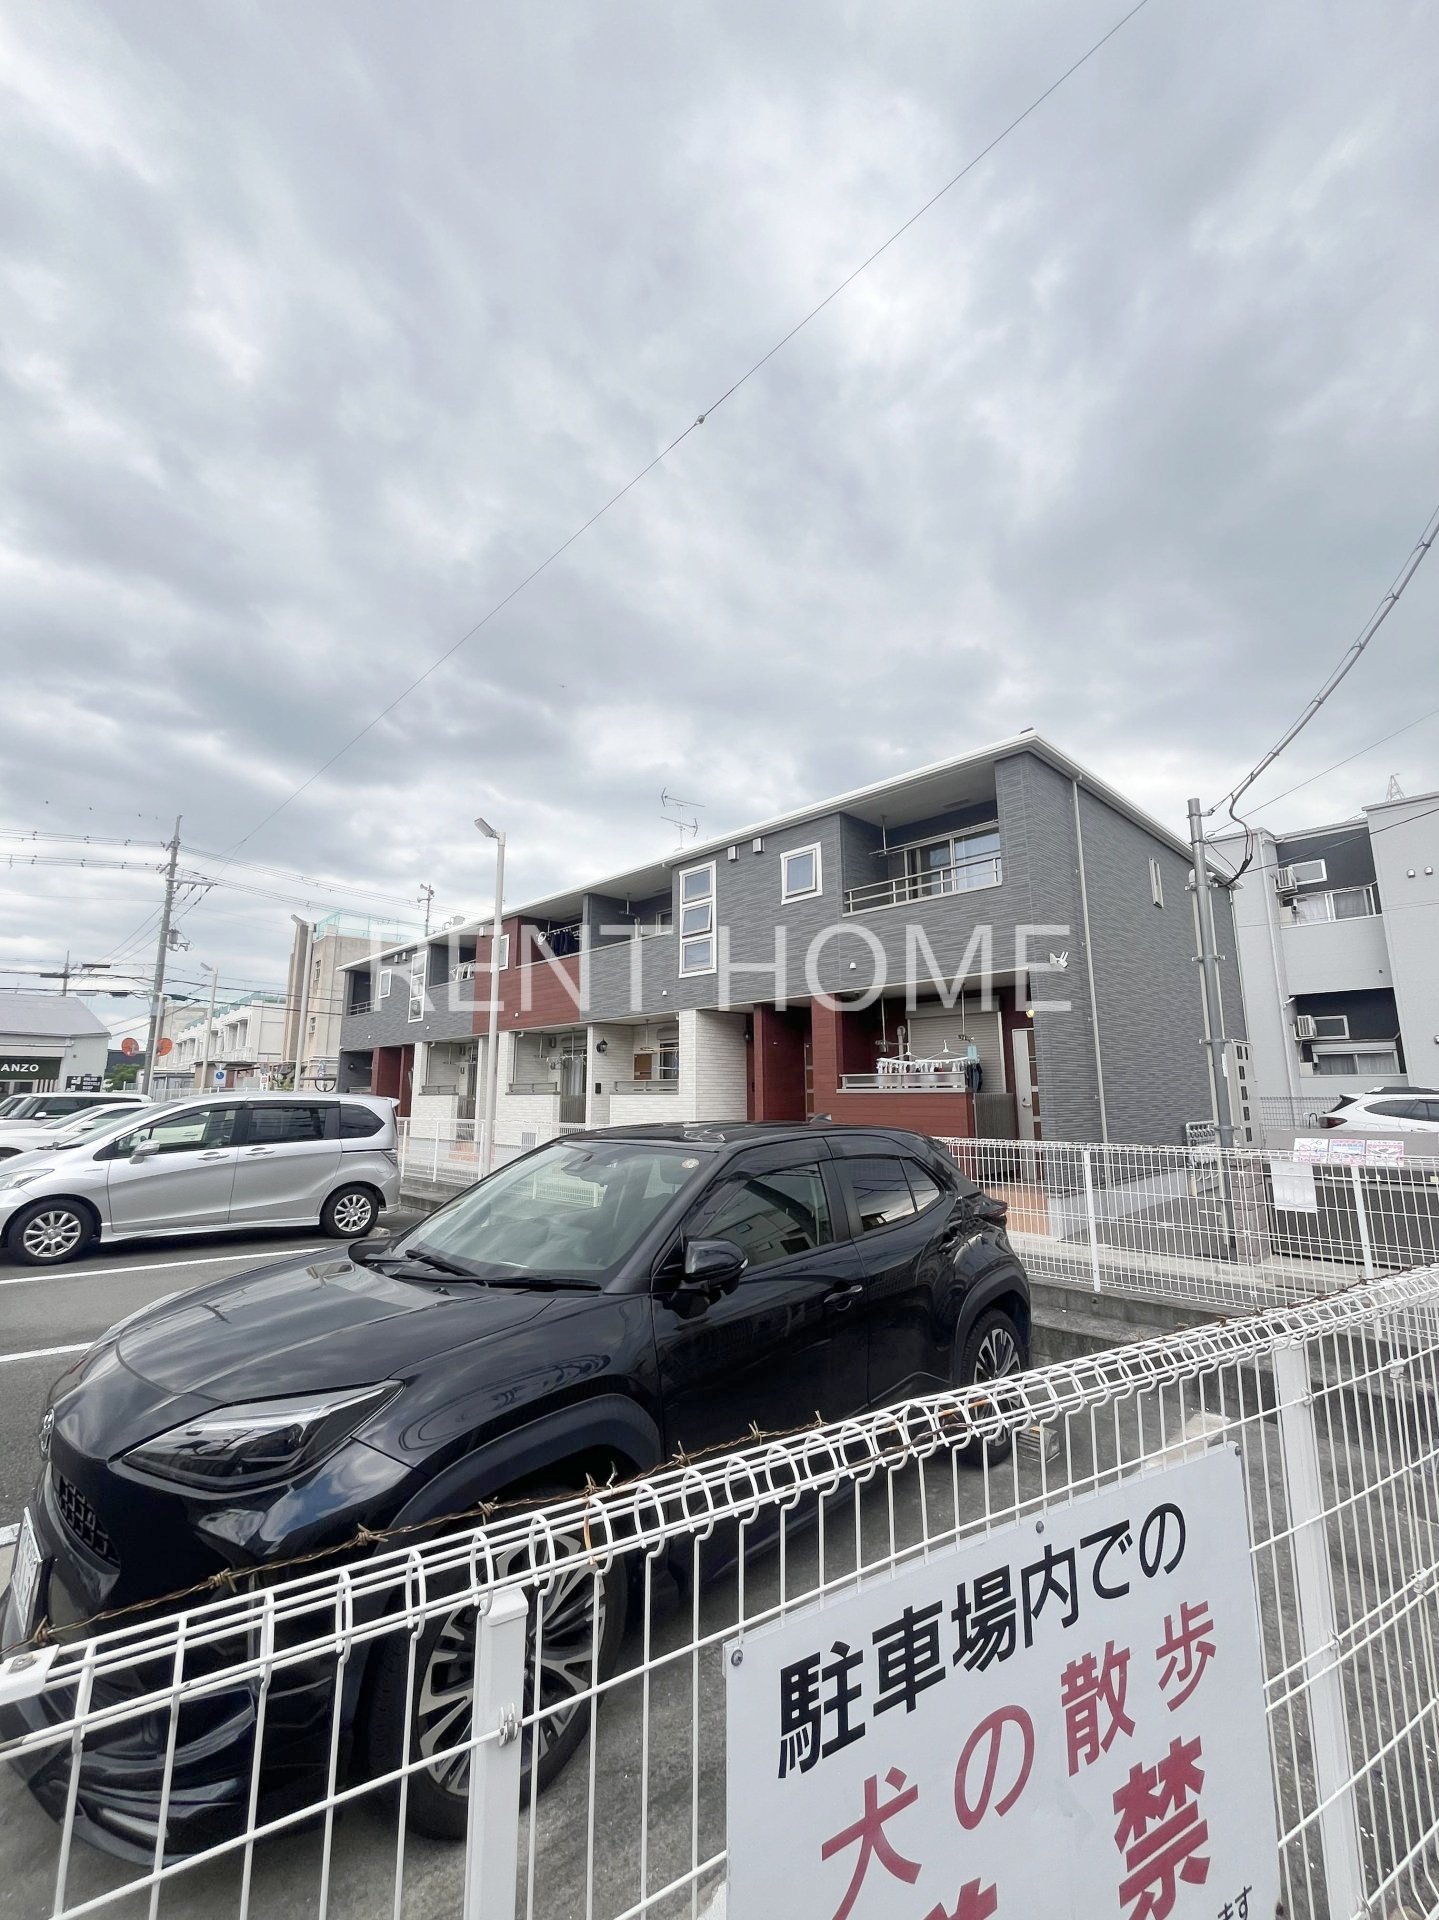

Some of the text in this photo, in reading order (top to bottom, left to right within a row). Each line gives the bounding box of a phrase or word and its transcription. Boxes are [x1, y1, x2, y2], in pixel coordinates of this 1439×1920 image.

[0, 1063, 39, 1072] ANZO
[778, 1503, 1187, 1778] 駐車場内での
[821, 1601, 1217, 1920] 犬の散歩
[922, 1736, 1210, 1920] 禁
